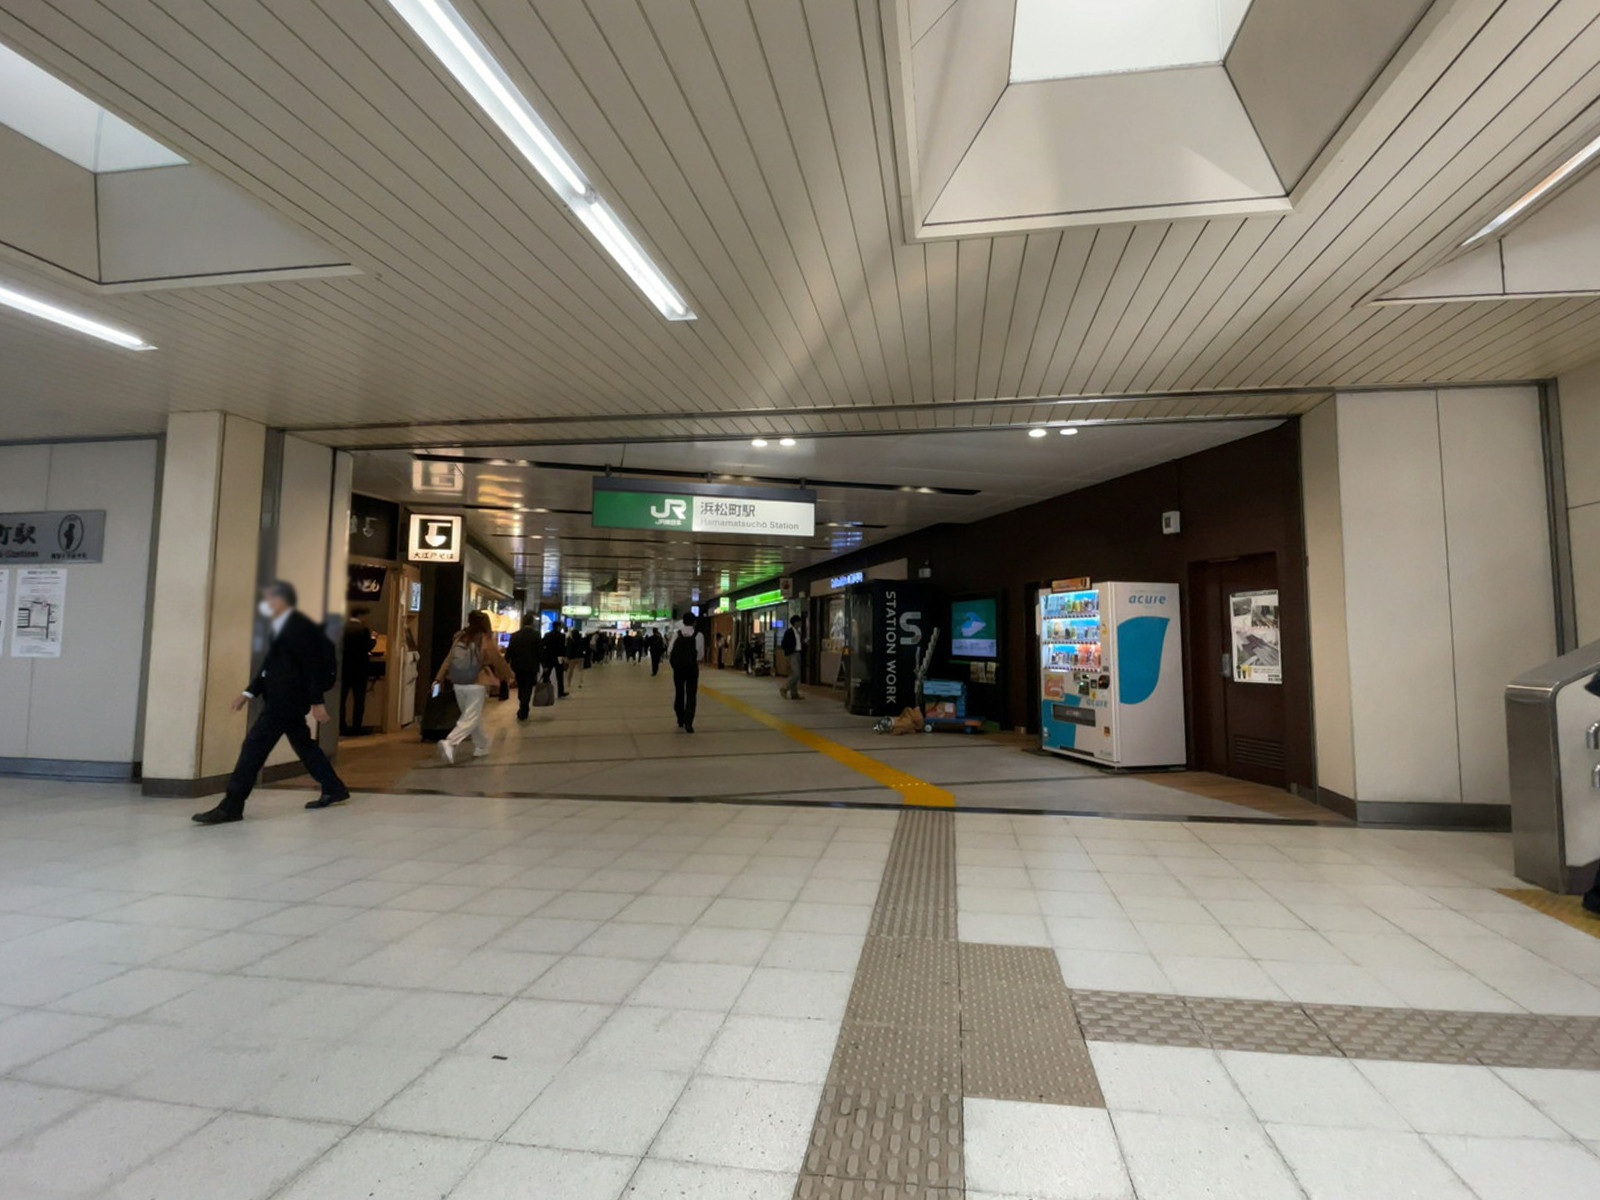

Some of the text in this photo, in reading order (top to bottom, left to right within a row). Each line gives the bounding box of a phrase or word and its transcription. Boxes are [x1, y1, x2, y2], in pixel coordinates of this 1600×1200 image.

[651, 498, 687, 519] JR
[701, 502, 756, 518] 浜松町駅
[769, 521, 800, 531] Station
[1128, 595, 1167, 605] acure
[885, 591, 897, 703] STATION WORK
